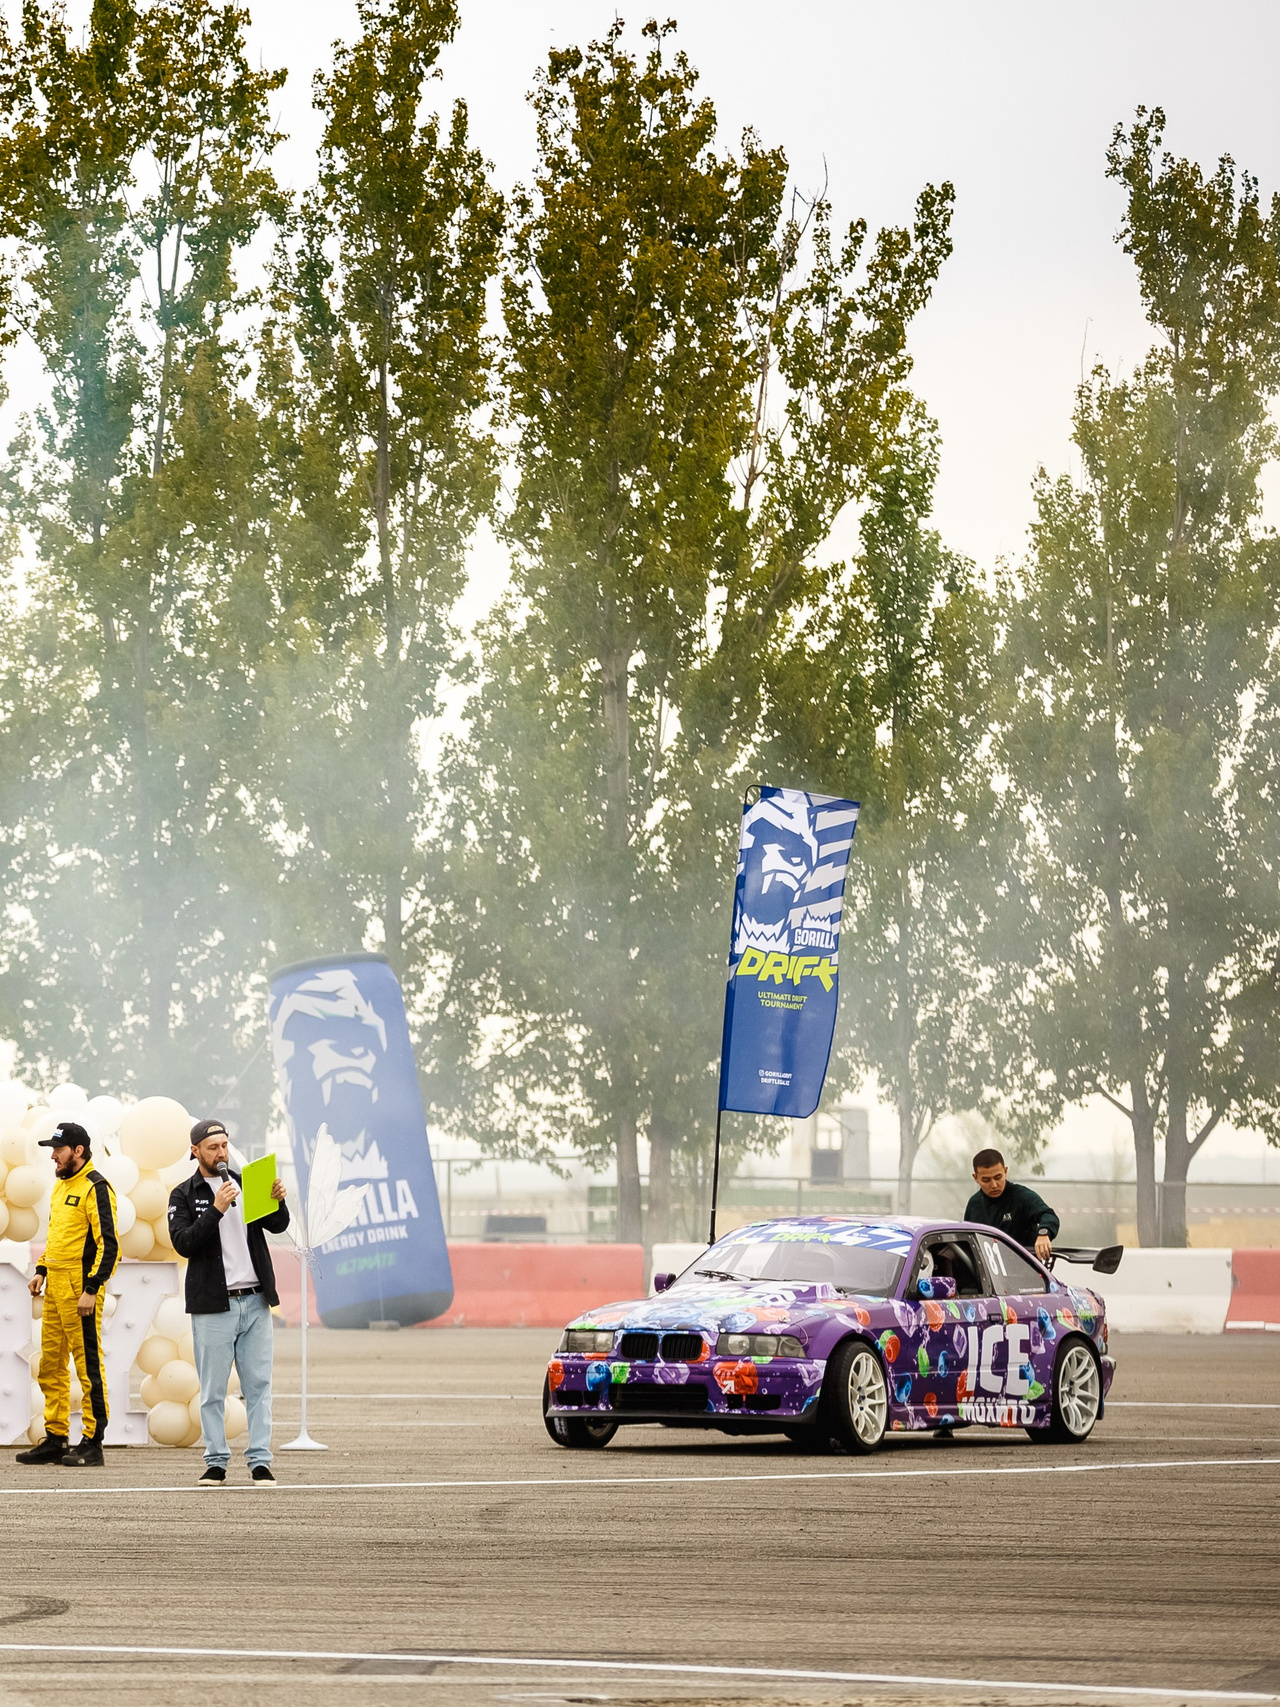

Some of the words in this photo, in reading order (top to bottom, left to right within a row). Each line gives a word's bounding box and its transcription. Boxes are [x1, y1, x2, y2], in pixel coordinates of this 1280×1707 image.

[794, 929, 835, 949] GORILLA
[736, 947, 838, 993] DRIFT
[758, 991, 791, 1001] ULTIMATE
[792, 995, 808, 1003] DRIFT
[760, 999, 804, 1010] TOURNAMENT
[366, 1224, 408, 1244] DRINK
[983, 1241, 1008, 1277] 81
[966, 1323, 1030, 1396] ICE
